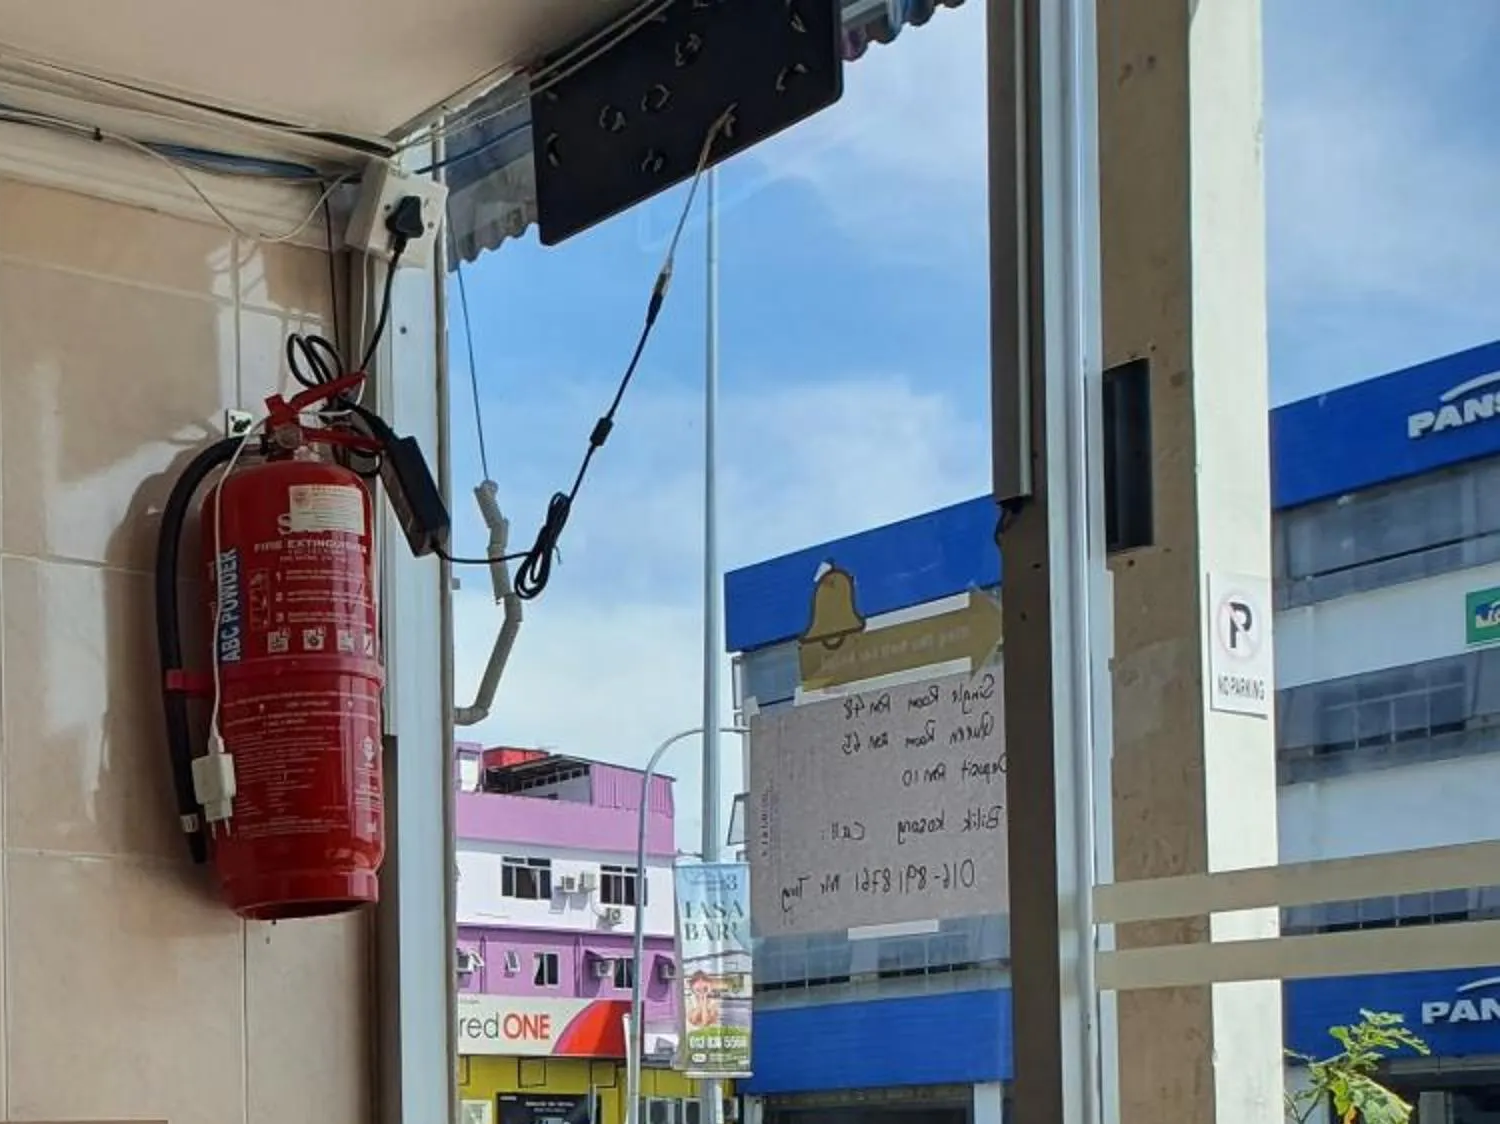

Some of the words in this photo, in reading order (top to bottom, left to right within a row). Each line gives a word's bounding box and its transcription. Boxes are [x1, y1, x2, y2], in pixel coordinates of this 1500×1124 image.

[1407, 391, 1500, 438] PAN
[221, 626, 242, 662] ABC
[1218, 674, 1229, 696] NO
[1230, 675, 1265, 701] PARKING
